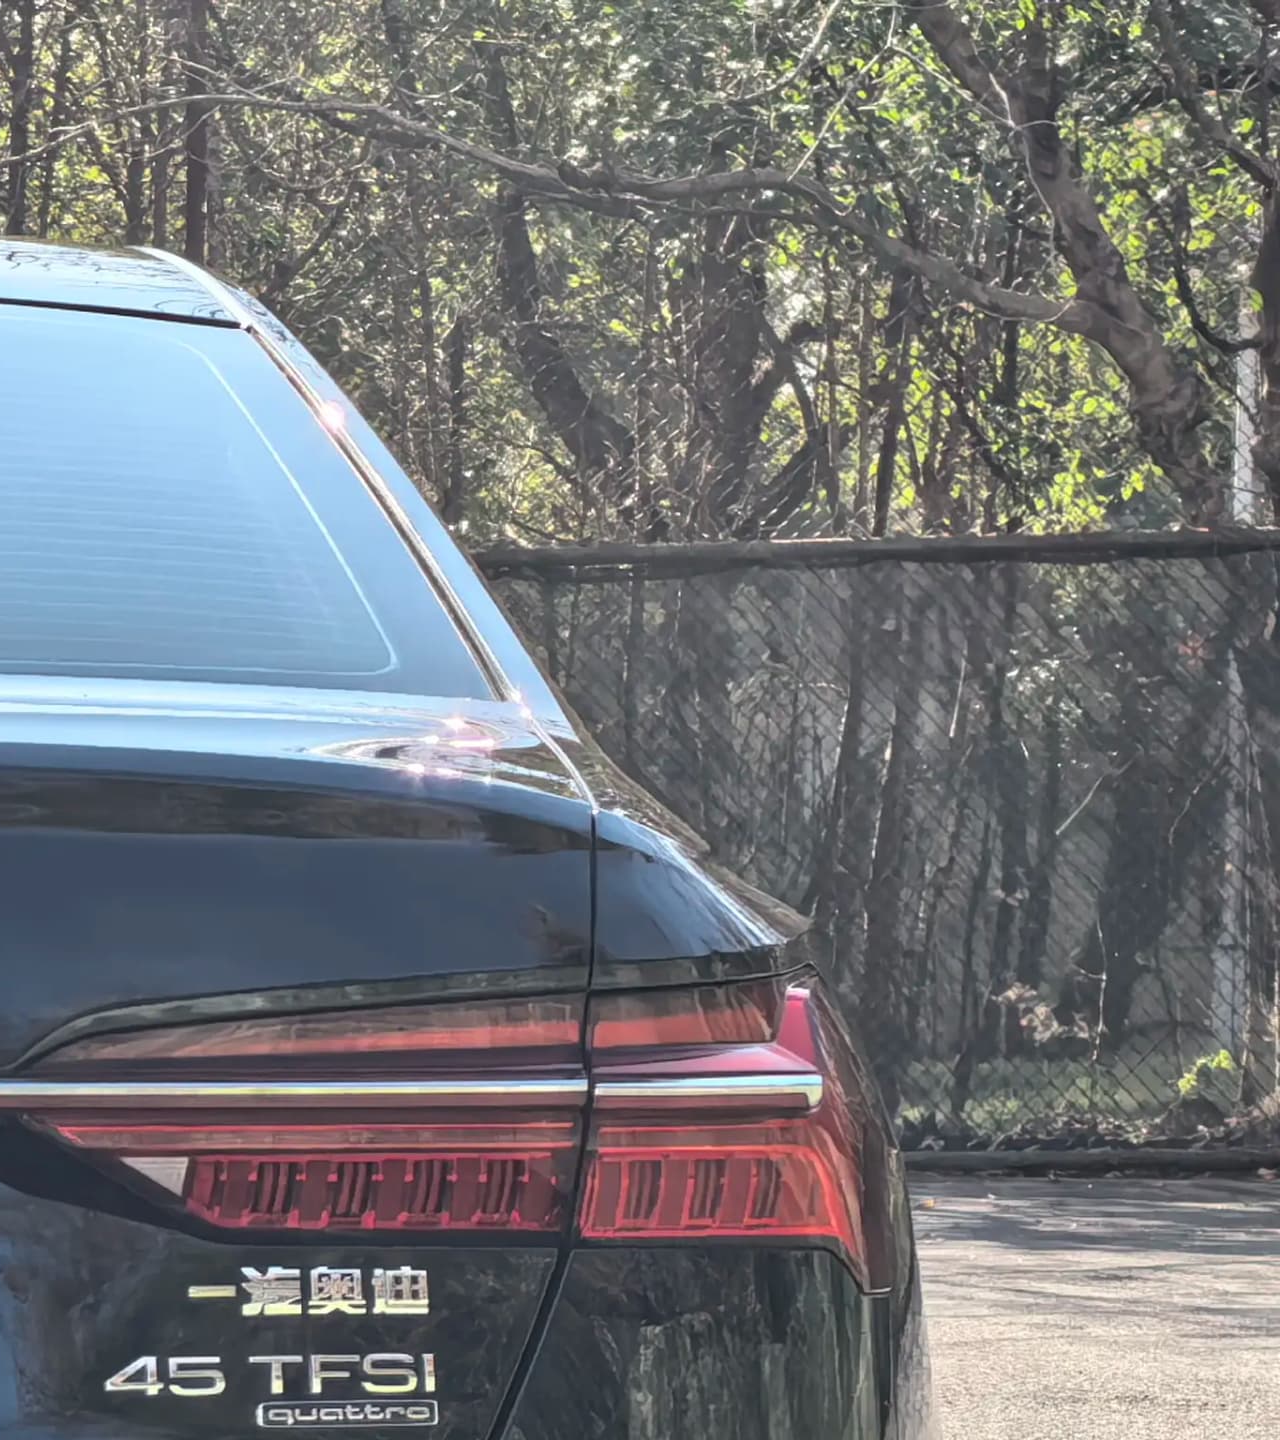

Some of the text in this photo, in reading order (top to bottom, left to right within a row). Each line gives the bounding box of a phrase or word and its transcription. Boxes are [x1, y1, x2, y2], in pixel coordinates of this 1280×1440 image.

[104, 1353, 439, 1397] 45 TFSI
[267, 1405, 431, 1426] quattro
